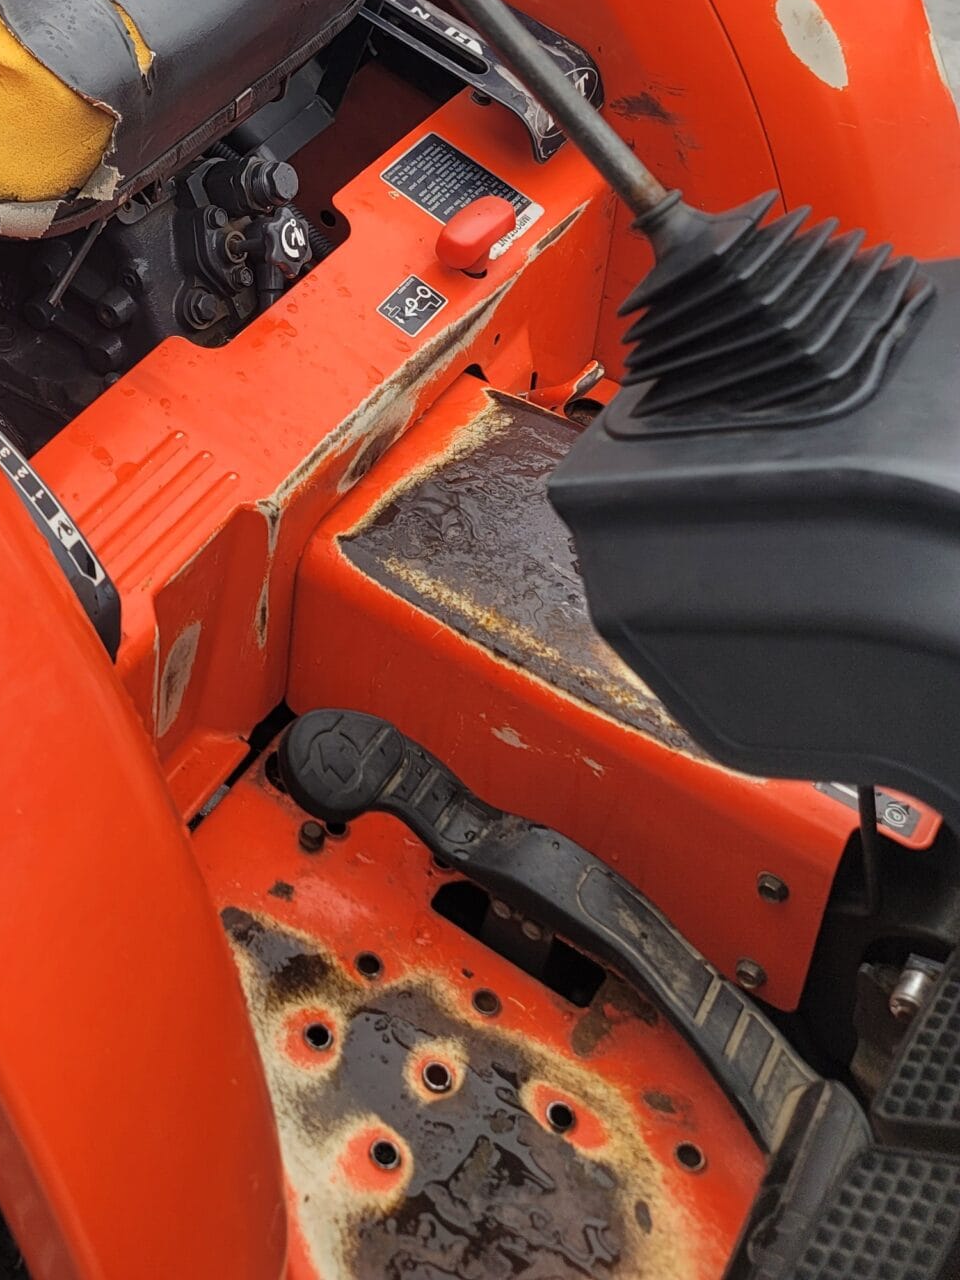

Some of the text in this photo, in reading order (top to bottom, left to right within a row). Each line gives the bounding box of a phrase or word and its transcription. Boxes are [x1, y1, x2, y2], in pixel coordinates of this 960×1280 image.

[0, 446, 10, 457] 3
[17, 466, 29, 478] 2
[35, 489, 44, 499] 1
